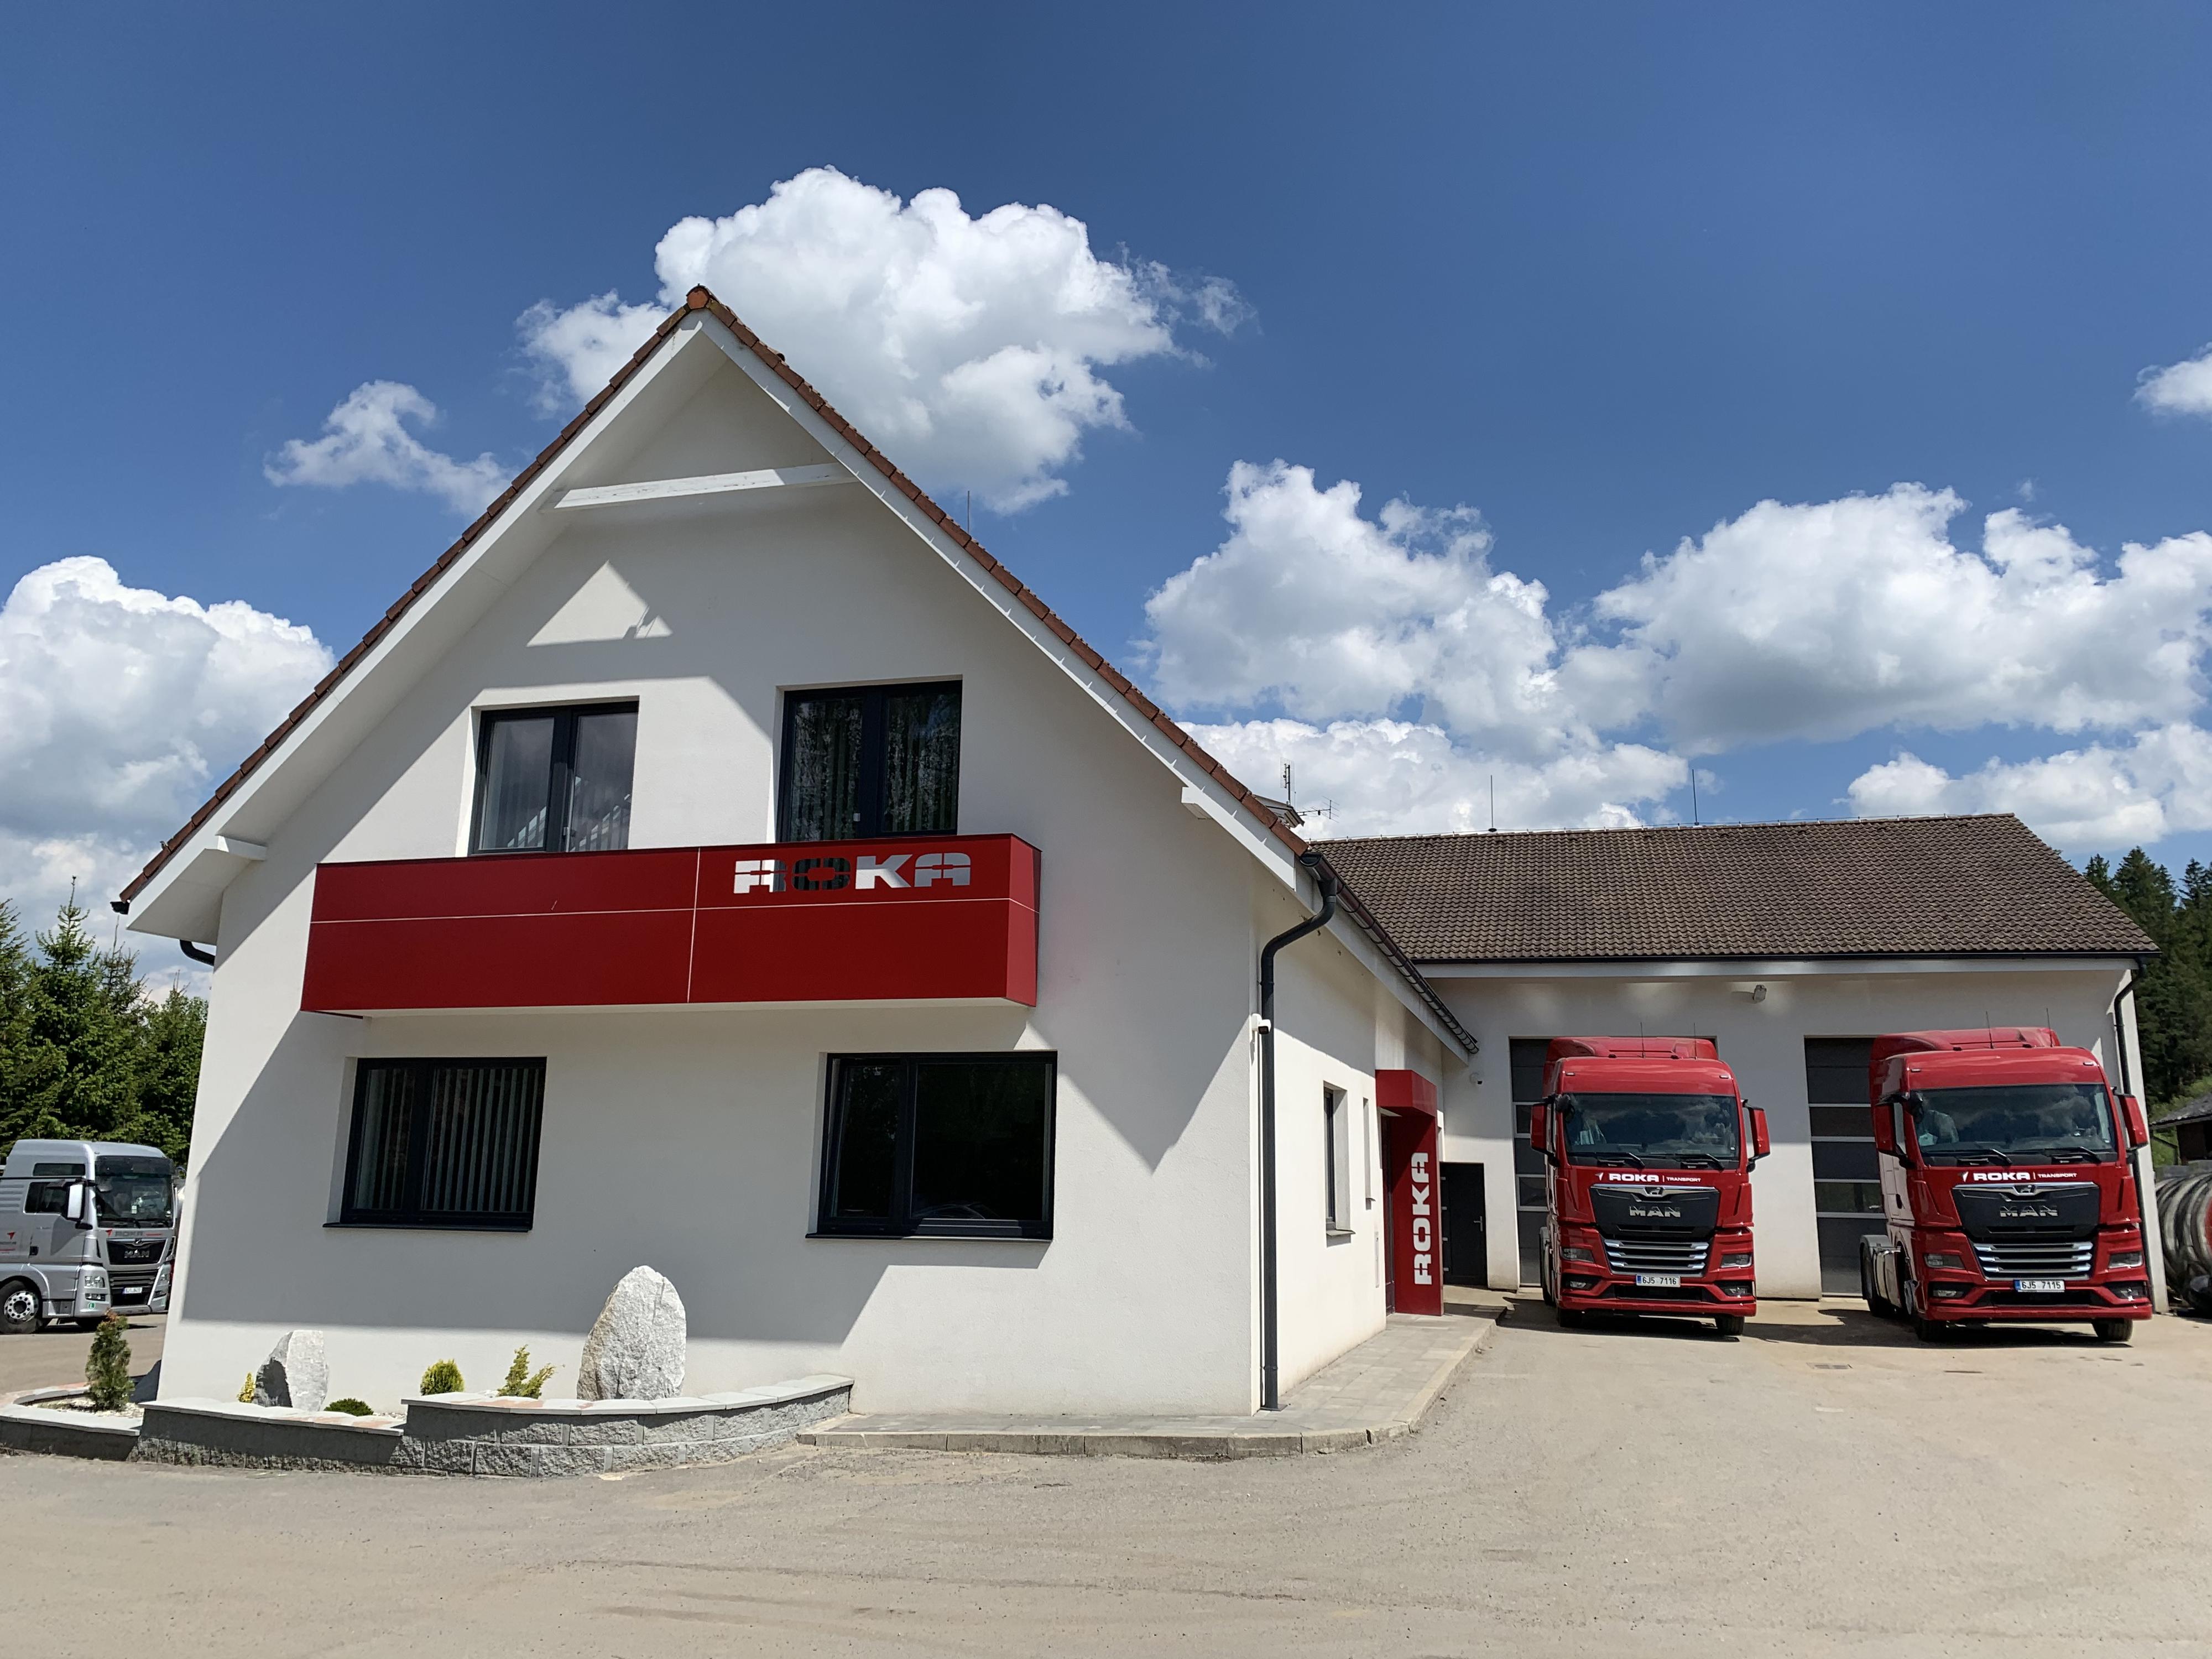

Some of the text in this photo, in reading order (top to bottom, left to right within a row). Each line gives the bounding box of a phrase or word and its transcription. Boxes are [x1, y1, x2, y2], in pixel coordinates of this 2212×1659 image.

[733, 852, 971, 894] ROKA
[1609, 1173, 1660, 1182] ROKA
[1973, 1172, 2031, 1181] ROKA
[1629, 1206, 1681, 1218] MAN
[2000, 1205, 2058, 1217] MAN
[1411, 1152, 1432, 1285] ROKA
[2022, 1281, 2061, 1289] 6J5 7115
